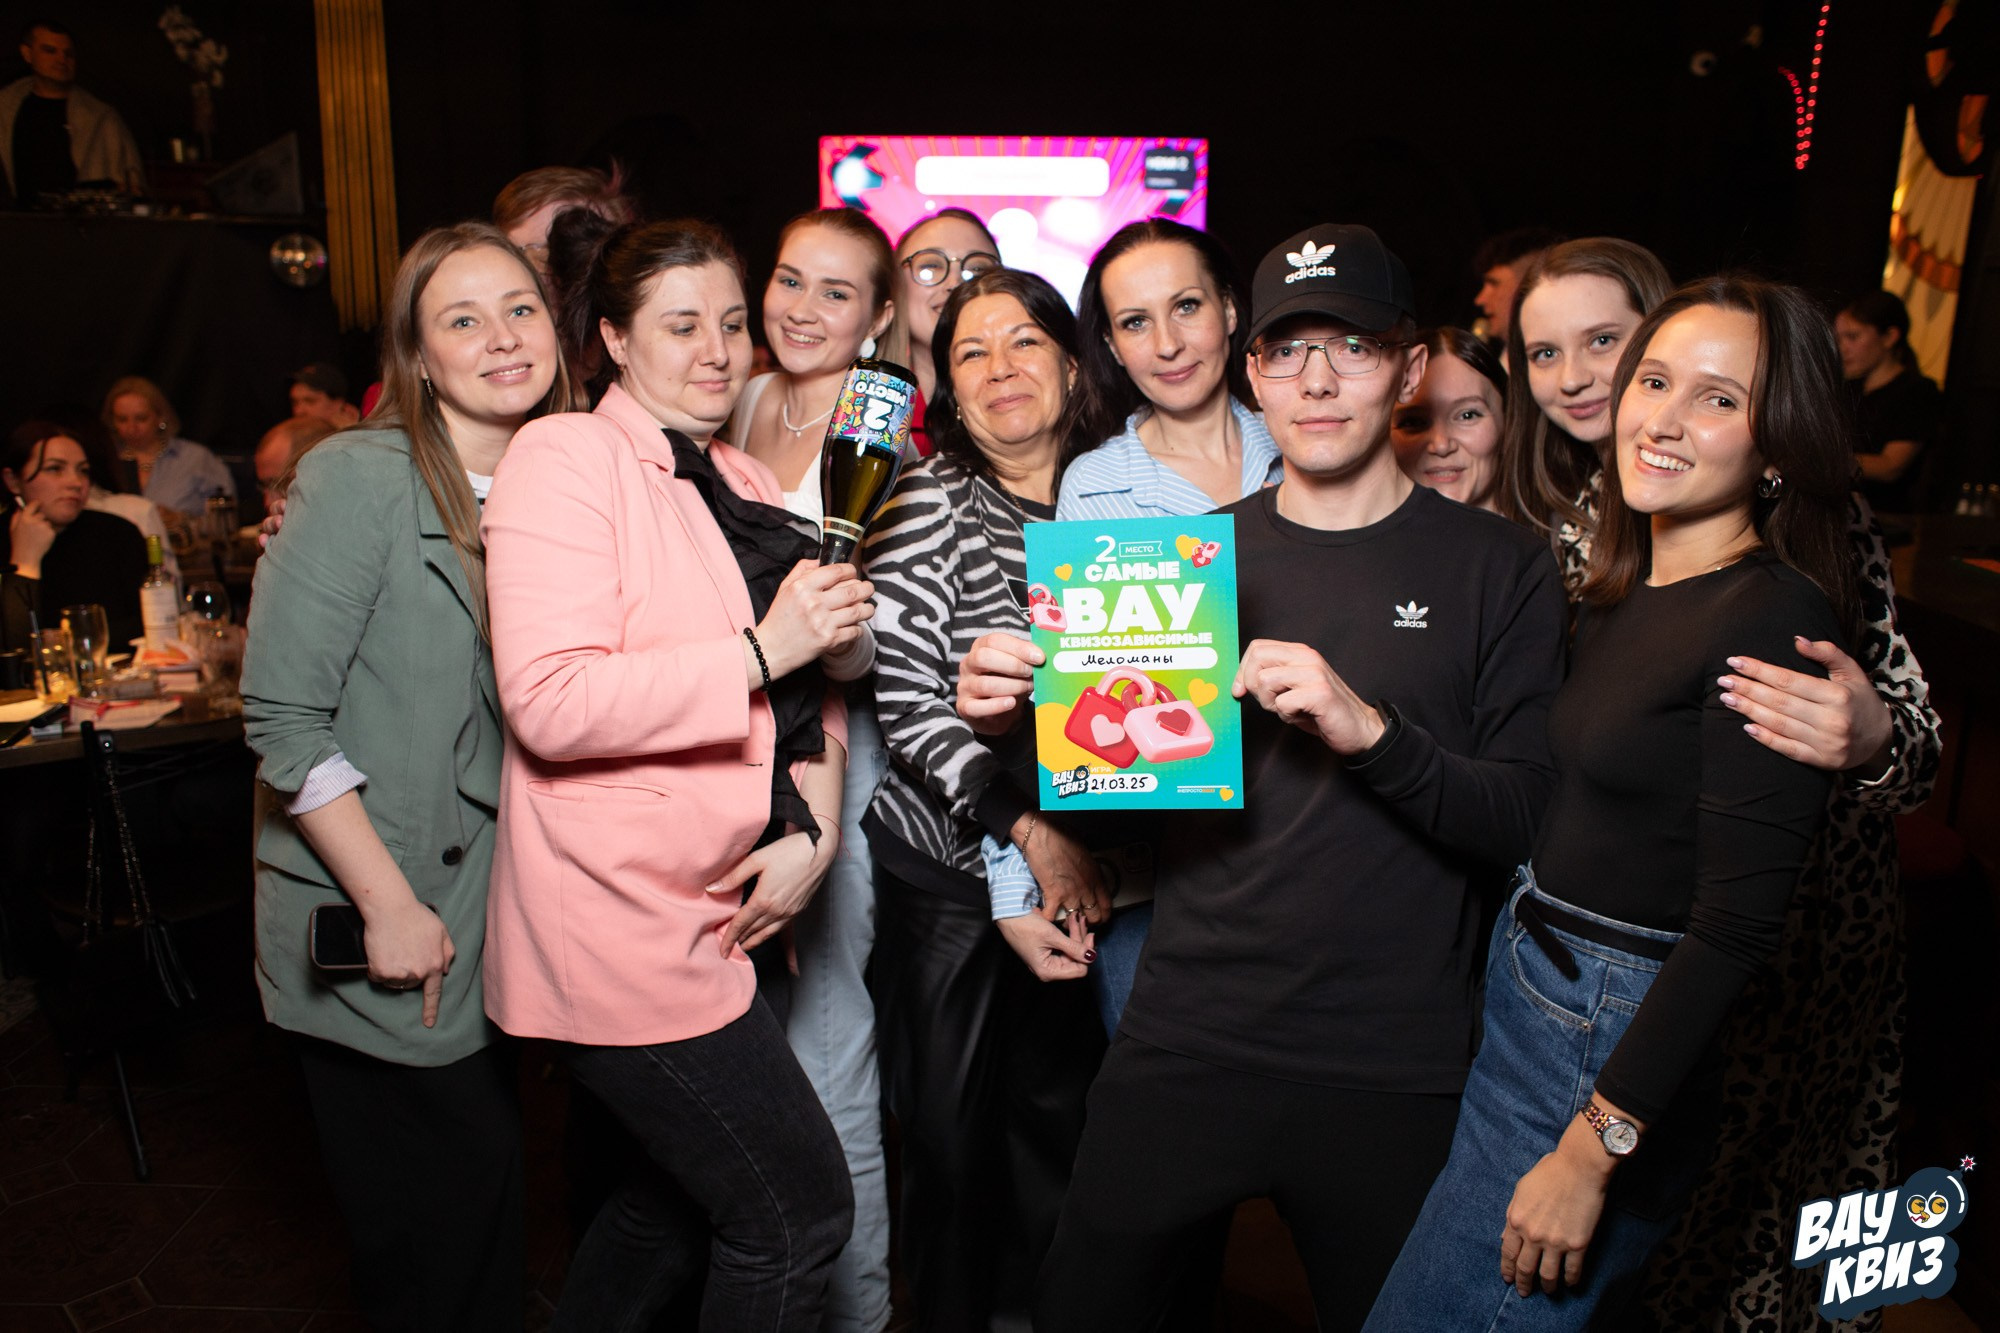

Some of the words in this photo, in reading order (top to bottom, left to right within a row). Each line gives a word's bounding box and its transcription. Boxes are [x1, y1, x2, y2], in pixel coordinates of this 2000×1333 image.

[1285, 265, 1336, 284] adidas
[854, 381, 907, 407] МЕСТО
[863, 397, 893, 430] 2
[1095, 535, 1117, 562] 2
[1125, 545, 1154, 553] МЕСТО
[1084, 561, 1180, 582] САМЫЕ
[1062, 583, 1206, 634] ВАУ
[1393, 619, 1427, 628] adidas
[1060, 632, 1212, 648] КВИЗОЗАВИСИМЫЕ
[1081, 655, 1173, 666] Меломаны
[1052, 770, 1075, 786] ВАУ
[1091, 777, 1148, 790] 21.03.25
[1058, 781, 1086, 796] КВИЗ
